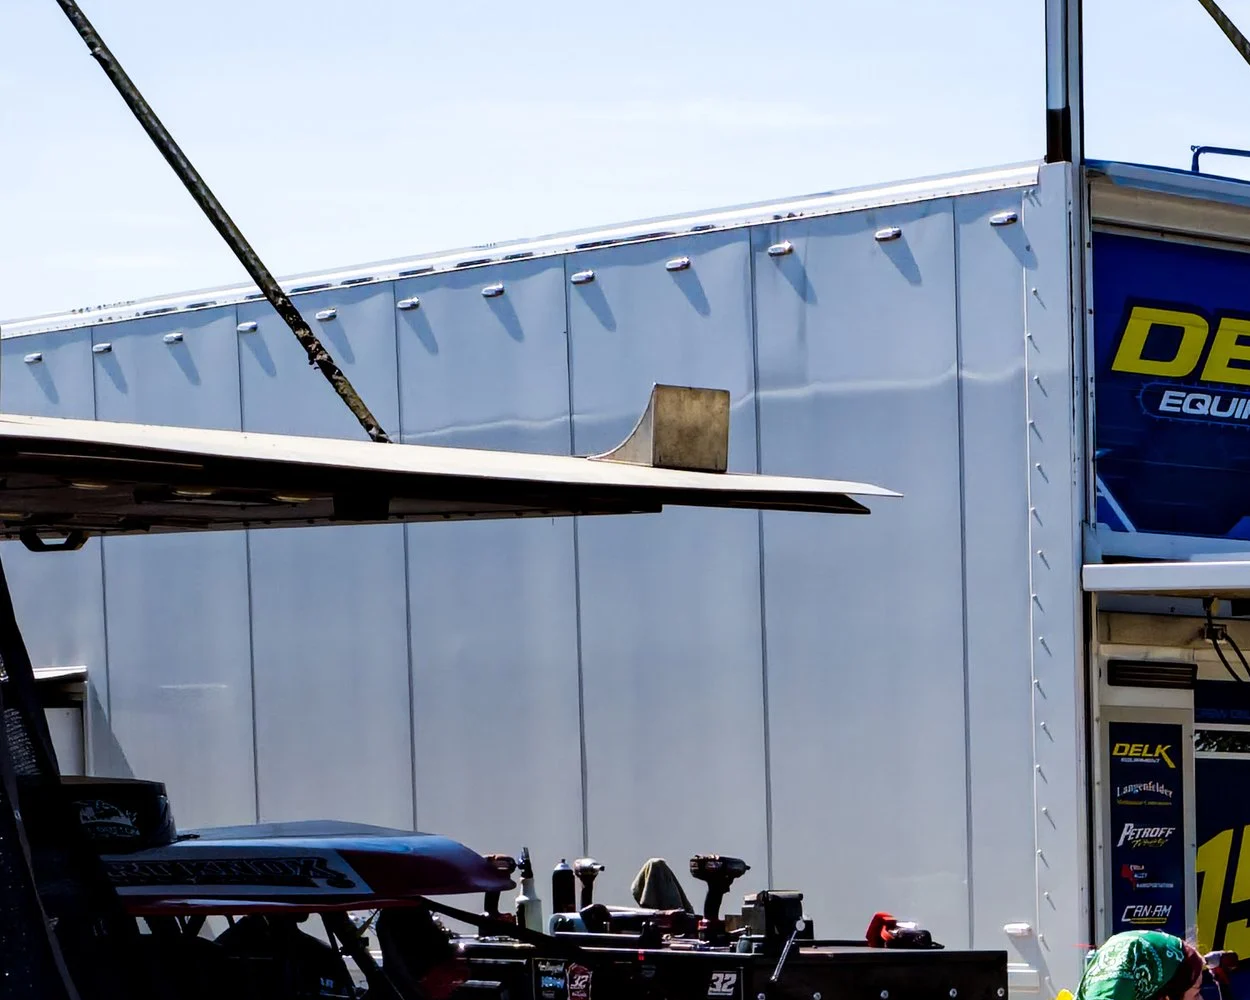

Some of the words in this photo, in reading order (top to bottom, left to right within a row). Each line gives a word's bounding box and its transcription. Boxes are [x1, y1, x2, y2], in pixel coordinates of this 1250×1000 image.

[1112, 743, 1176, 769] DELK
[1116, 780, 1173, 799] Langenfelder
[1117, 822, 1176, 847] PETROFF
[707, 973, 738, 994] 32
